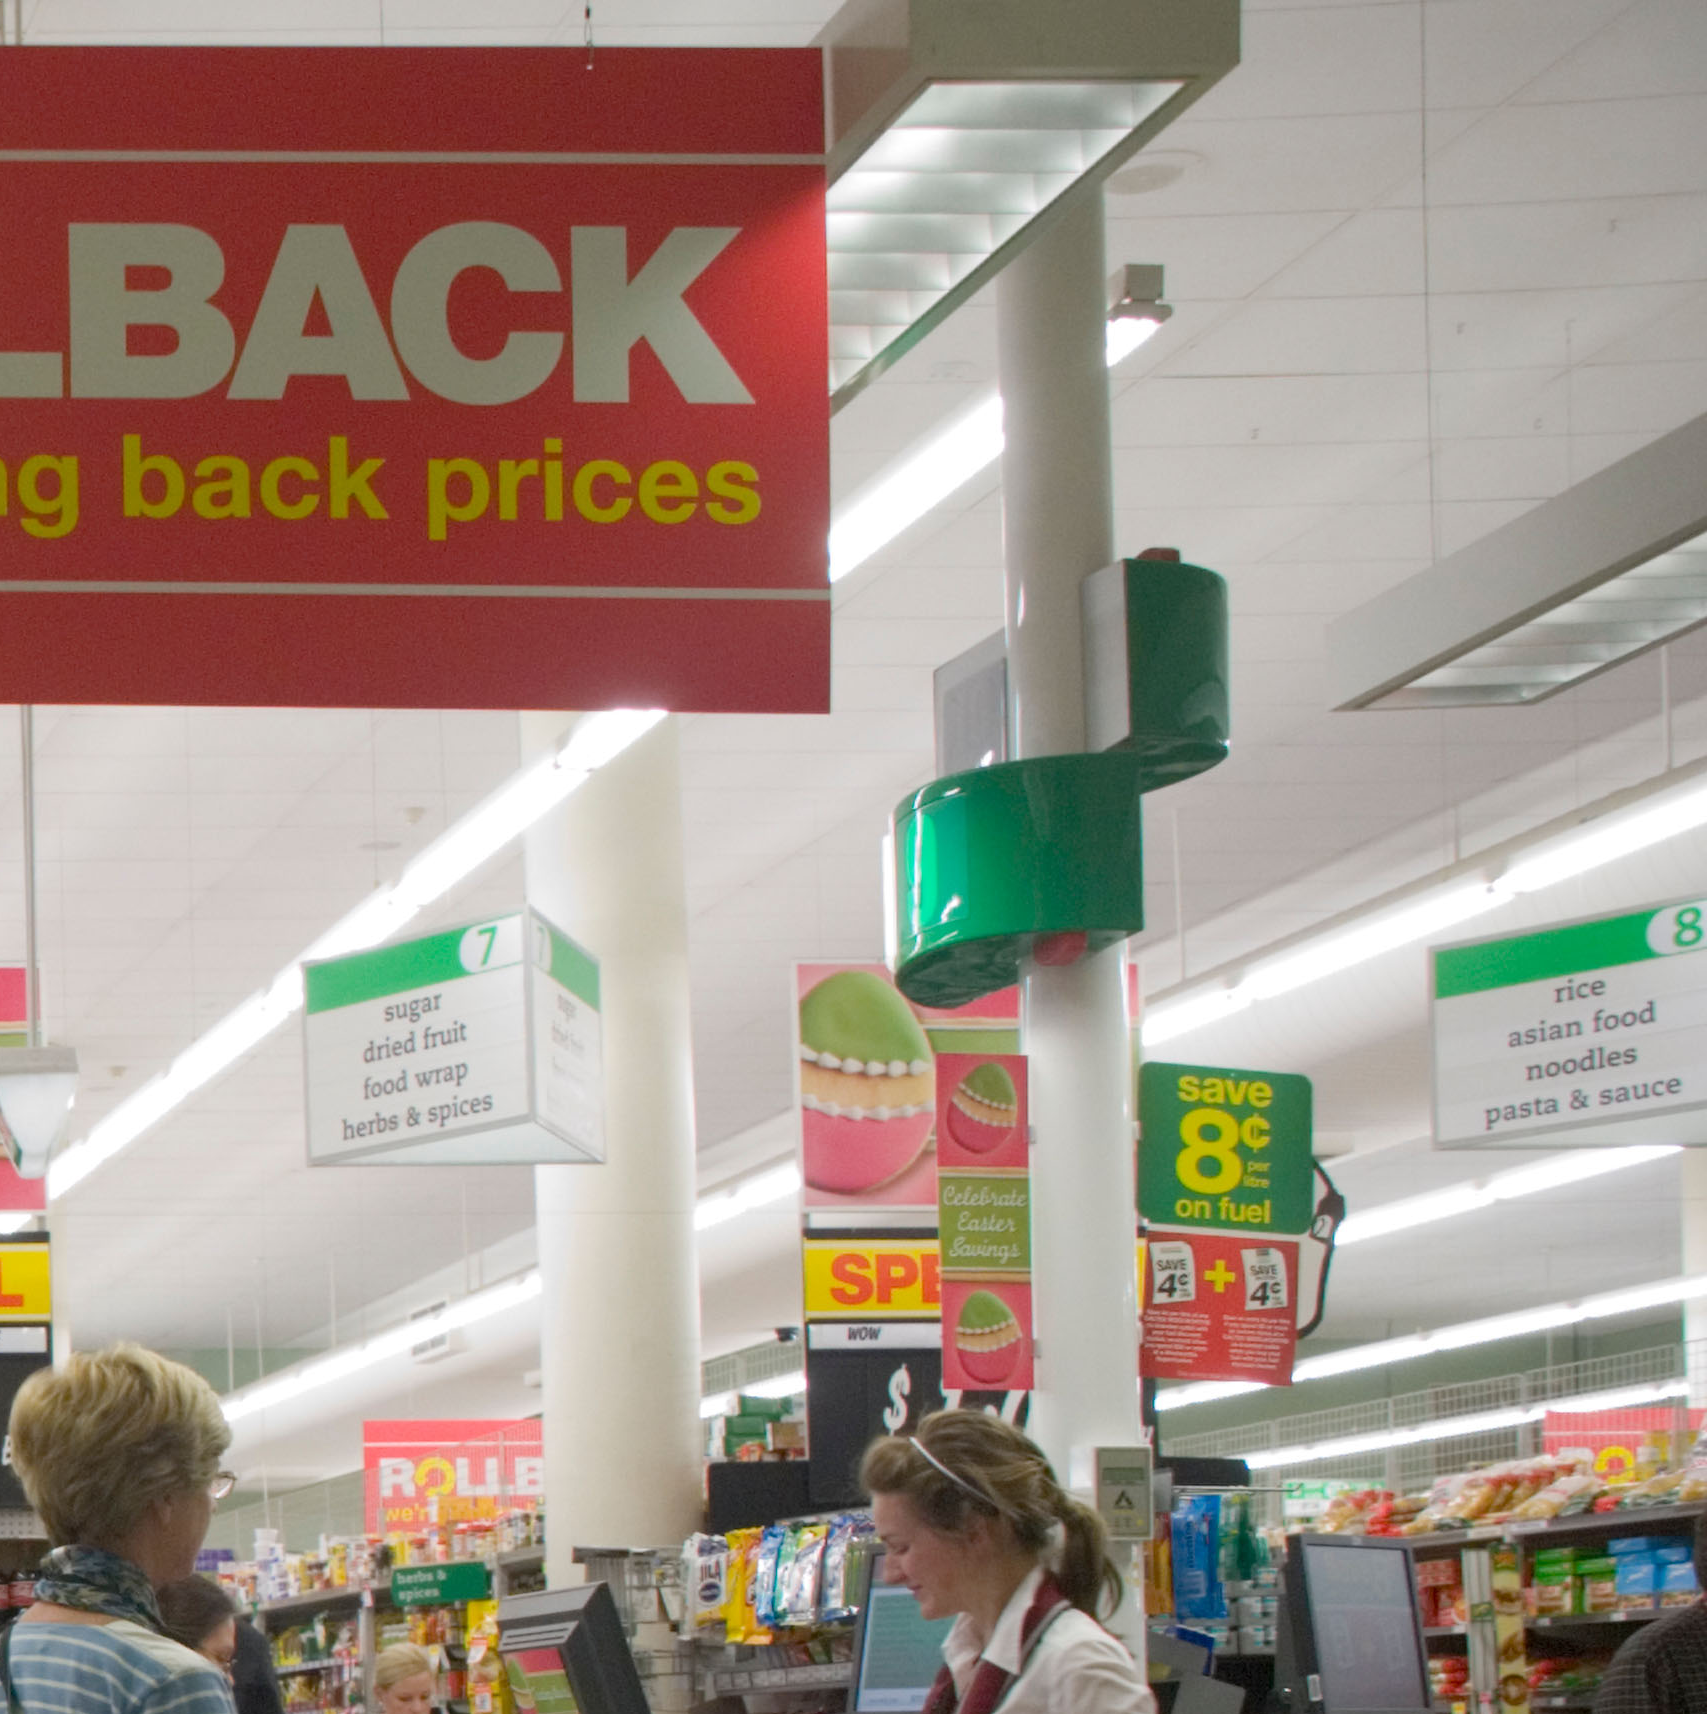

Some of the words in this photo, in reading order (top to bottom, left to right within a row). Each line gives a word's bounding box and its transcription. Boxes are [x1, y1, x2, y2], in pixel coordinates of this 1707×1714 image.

[121, 432, 388, 523] back
[428, 438, 762, 541] prices
[1675, 907, 1703, 946] 8
[477, 925, 498, 967] 7
[1554, 979, 1606, 1003] rice
[384, 994, 442, 1022] sugar
[1508, 1019, 1583, 1048] asian
[1594, 1000, 1657, 1032] food
[363, 1031, 416, 1063] dried
[422, 1020, 467, 1050] fruit
[1525, 1047, 1638, 1081] noodles
[363, 1070, 407, 1100] food
[415, 1062, 469, 1088] wrap
[1178, 1075, 1273, 1108] save
[342, 1112, 399, 1141] herbs
[406, 1106, 421, 1128] &
[428, 1093, 493, 1127] spices
[1484, 1097, 1559, 1130] pasta
[1570, 1089, 1589, 1110] &
[1599, 1077, 1683, 1106] sauce
[1247, 1160, 1270, 1173] per
[942, 1183, 1027, 1207] Celebrate
[957, 1212, 1016, 1232] Easter
[1175, 1198, 1211, 1219] on
[1219, 1197, 1271, 1224] fuel
[949, 1237, 1021, 1264] Savings
[848, 1326, 881, 1341] WOW
[396, 1572, 434, 1585] herbs
[398, 1587, 440, 1601] spices
